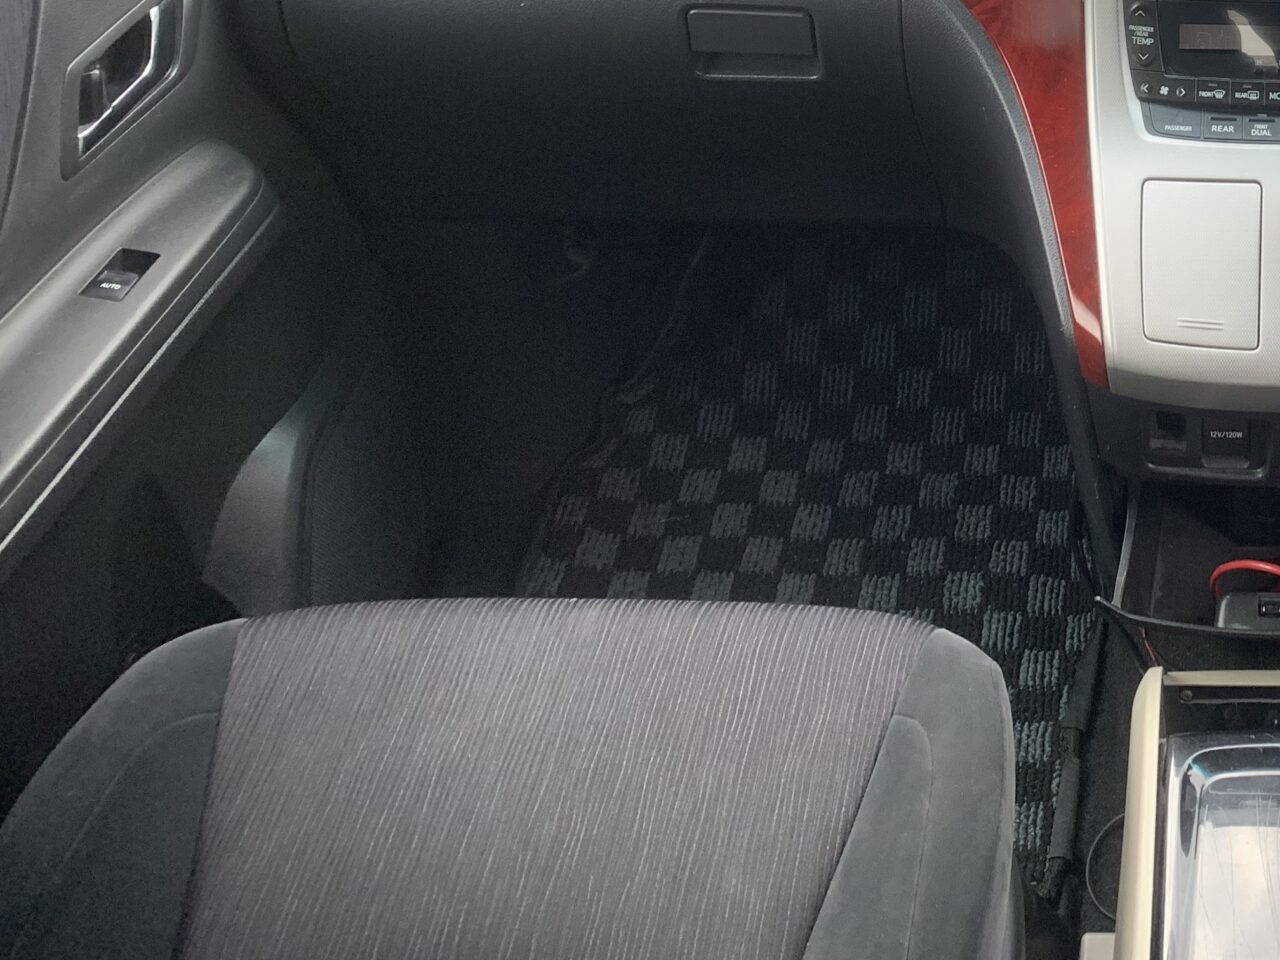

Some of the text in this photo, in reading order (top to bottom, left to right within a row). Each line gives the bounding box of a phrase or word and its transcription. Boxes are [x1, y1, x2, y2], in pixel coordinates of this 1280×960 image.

[1132, 36, 1154, 46] TEMP
[1198, 90, 1213, 98] FRONT
[1211, 124, 1235, 133] REAR
[1251, 128, 1272, 136] DUAL
[99, 282, 121, 290] AUTO
